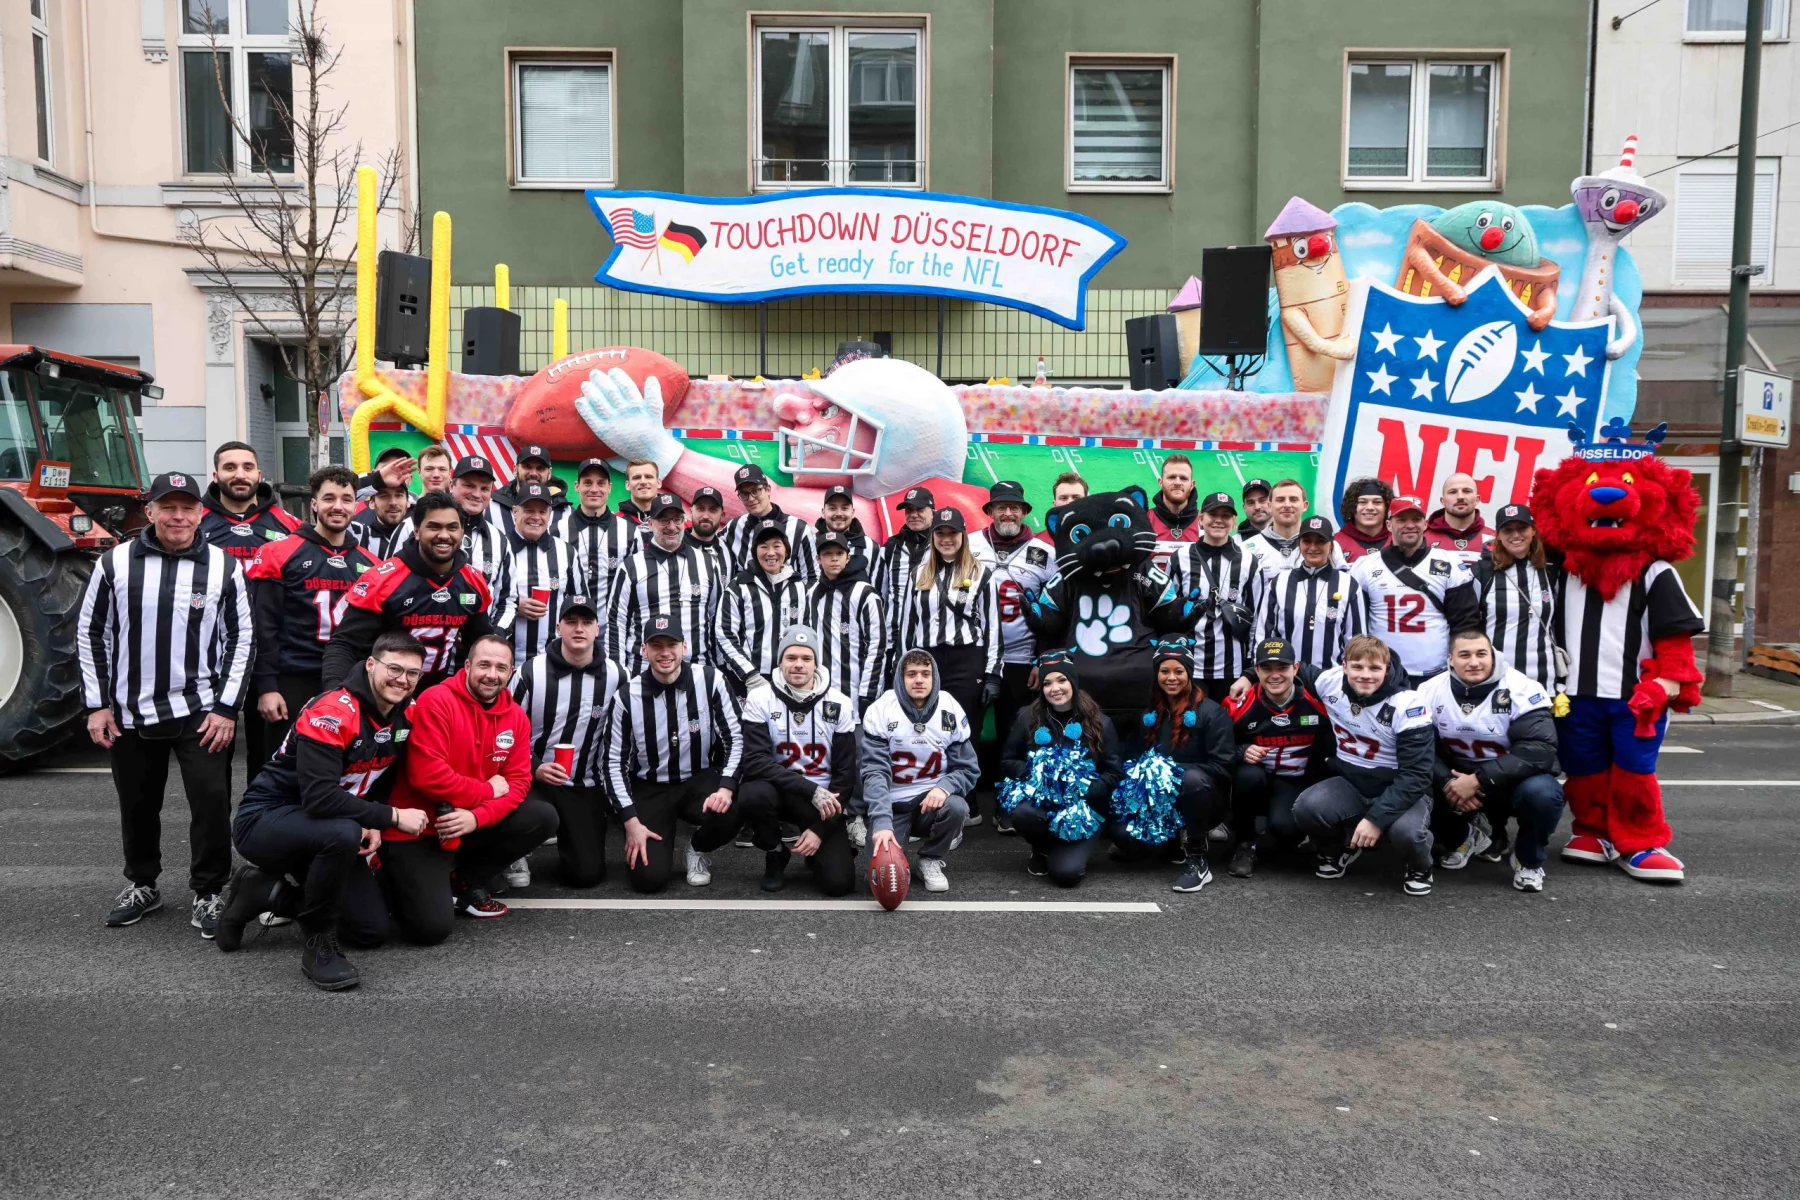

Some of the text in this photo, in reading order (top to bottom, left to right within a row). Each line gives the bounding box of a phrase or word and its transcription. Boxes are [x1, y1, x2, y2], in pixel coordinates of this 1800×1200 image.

[710, 211, 1081, 268] TOUCHDOWN DÜSSELDORF
[770, 249, 1004, 288] Get ready for the NFL
[1377, 417, 1546, 518] NFL
[1384, 593, 1426, 633] 12
[776, 741, 828, 776] 22
[1334, 723, 1381, 760] 27
[892, 750, 943, 785] 24
